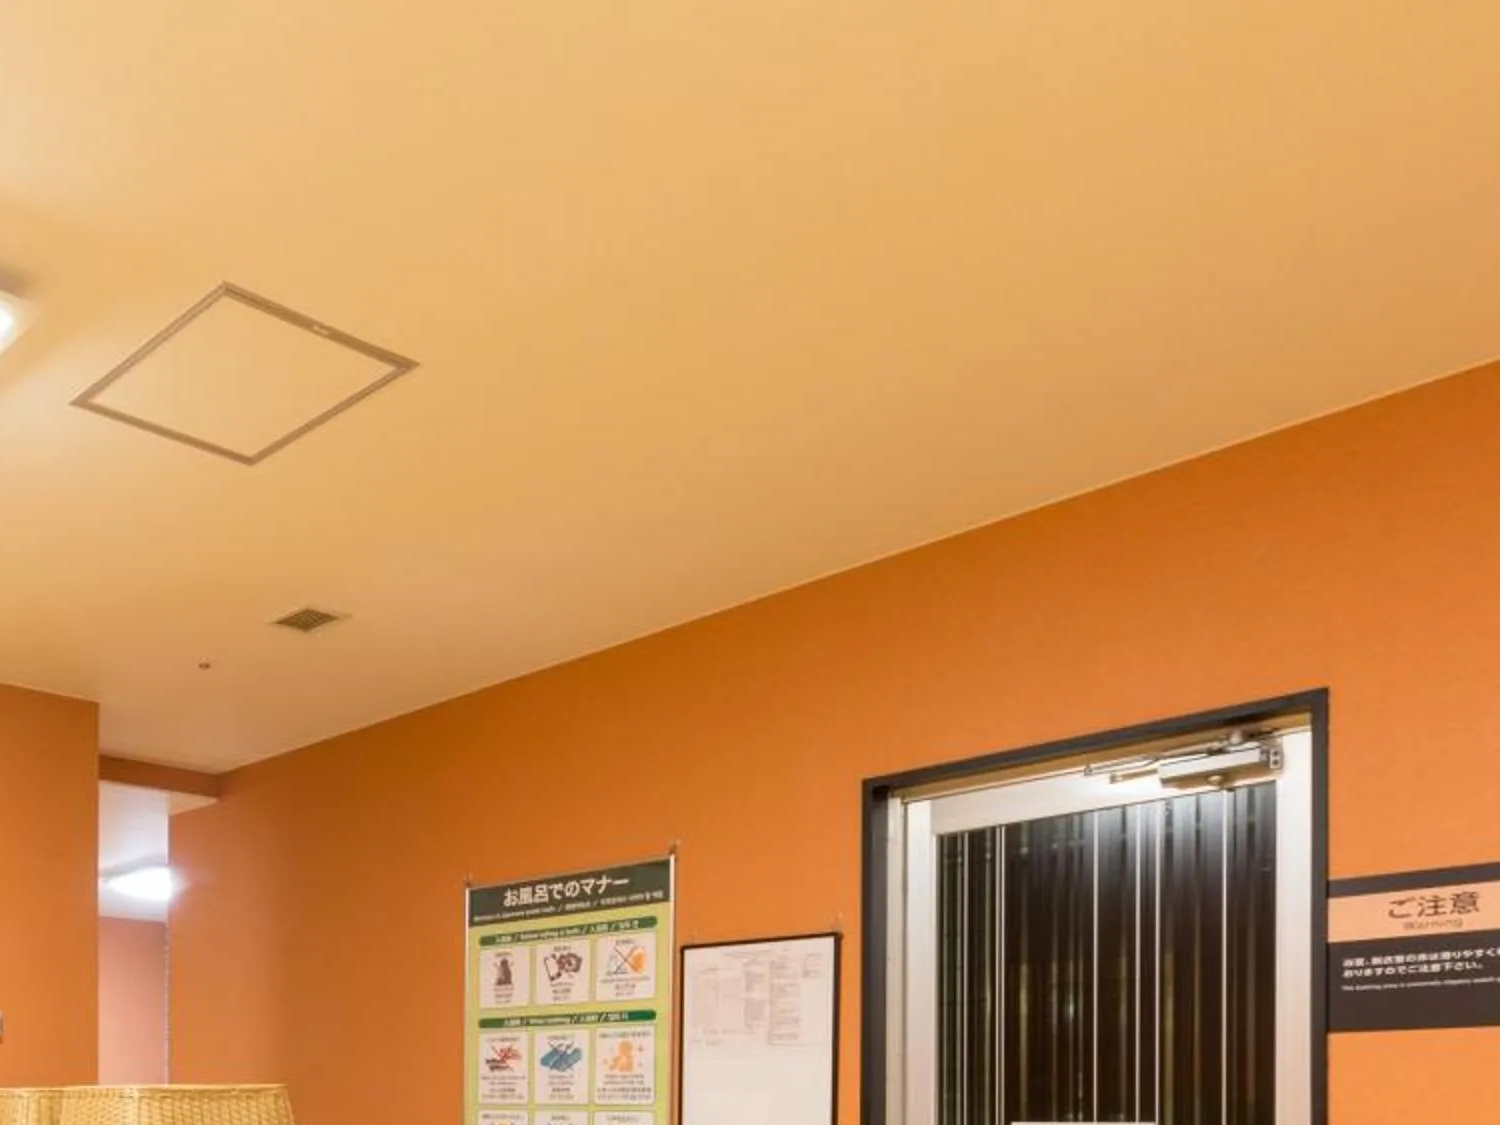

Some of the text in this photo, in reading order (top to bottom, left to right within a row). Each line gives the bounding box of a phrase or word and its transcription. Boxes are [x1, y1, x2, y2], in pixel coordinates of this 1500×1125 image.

[502, 874, 630, 907] お風呂でのマナー
[1388, 892, 1480, 919] ご注意
